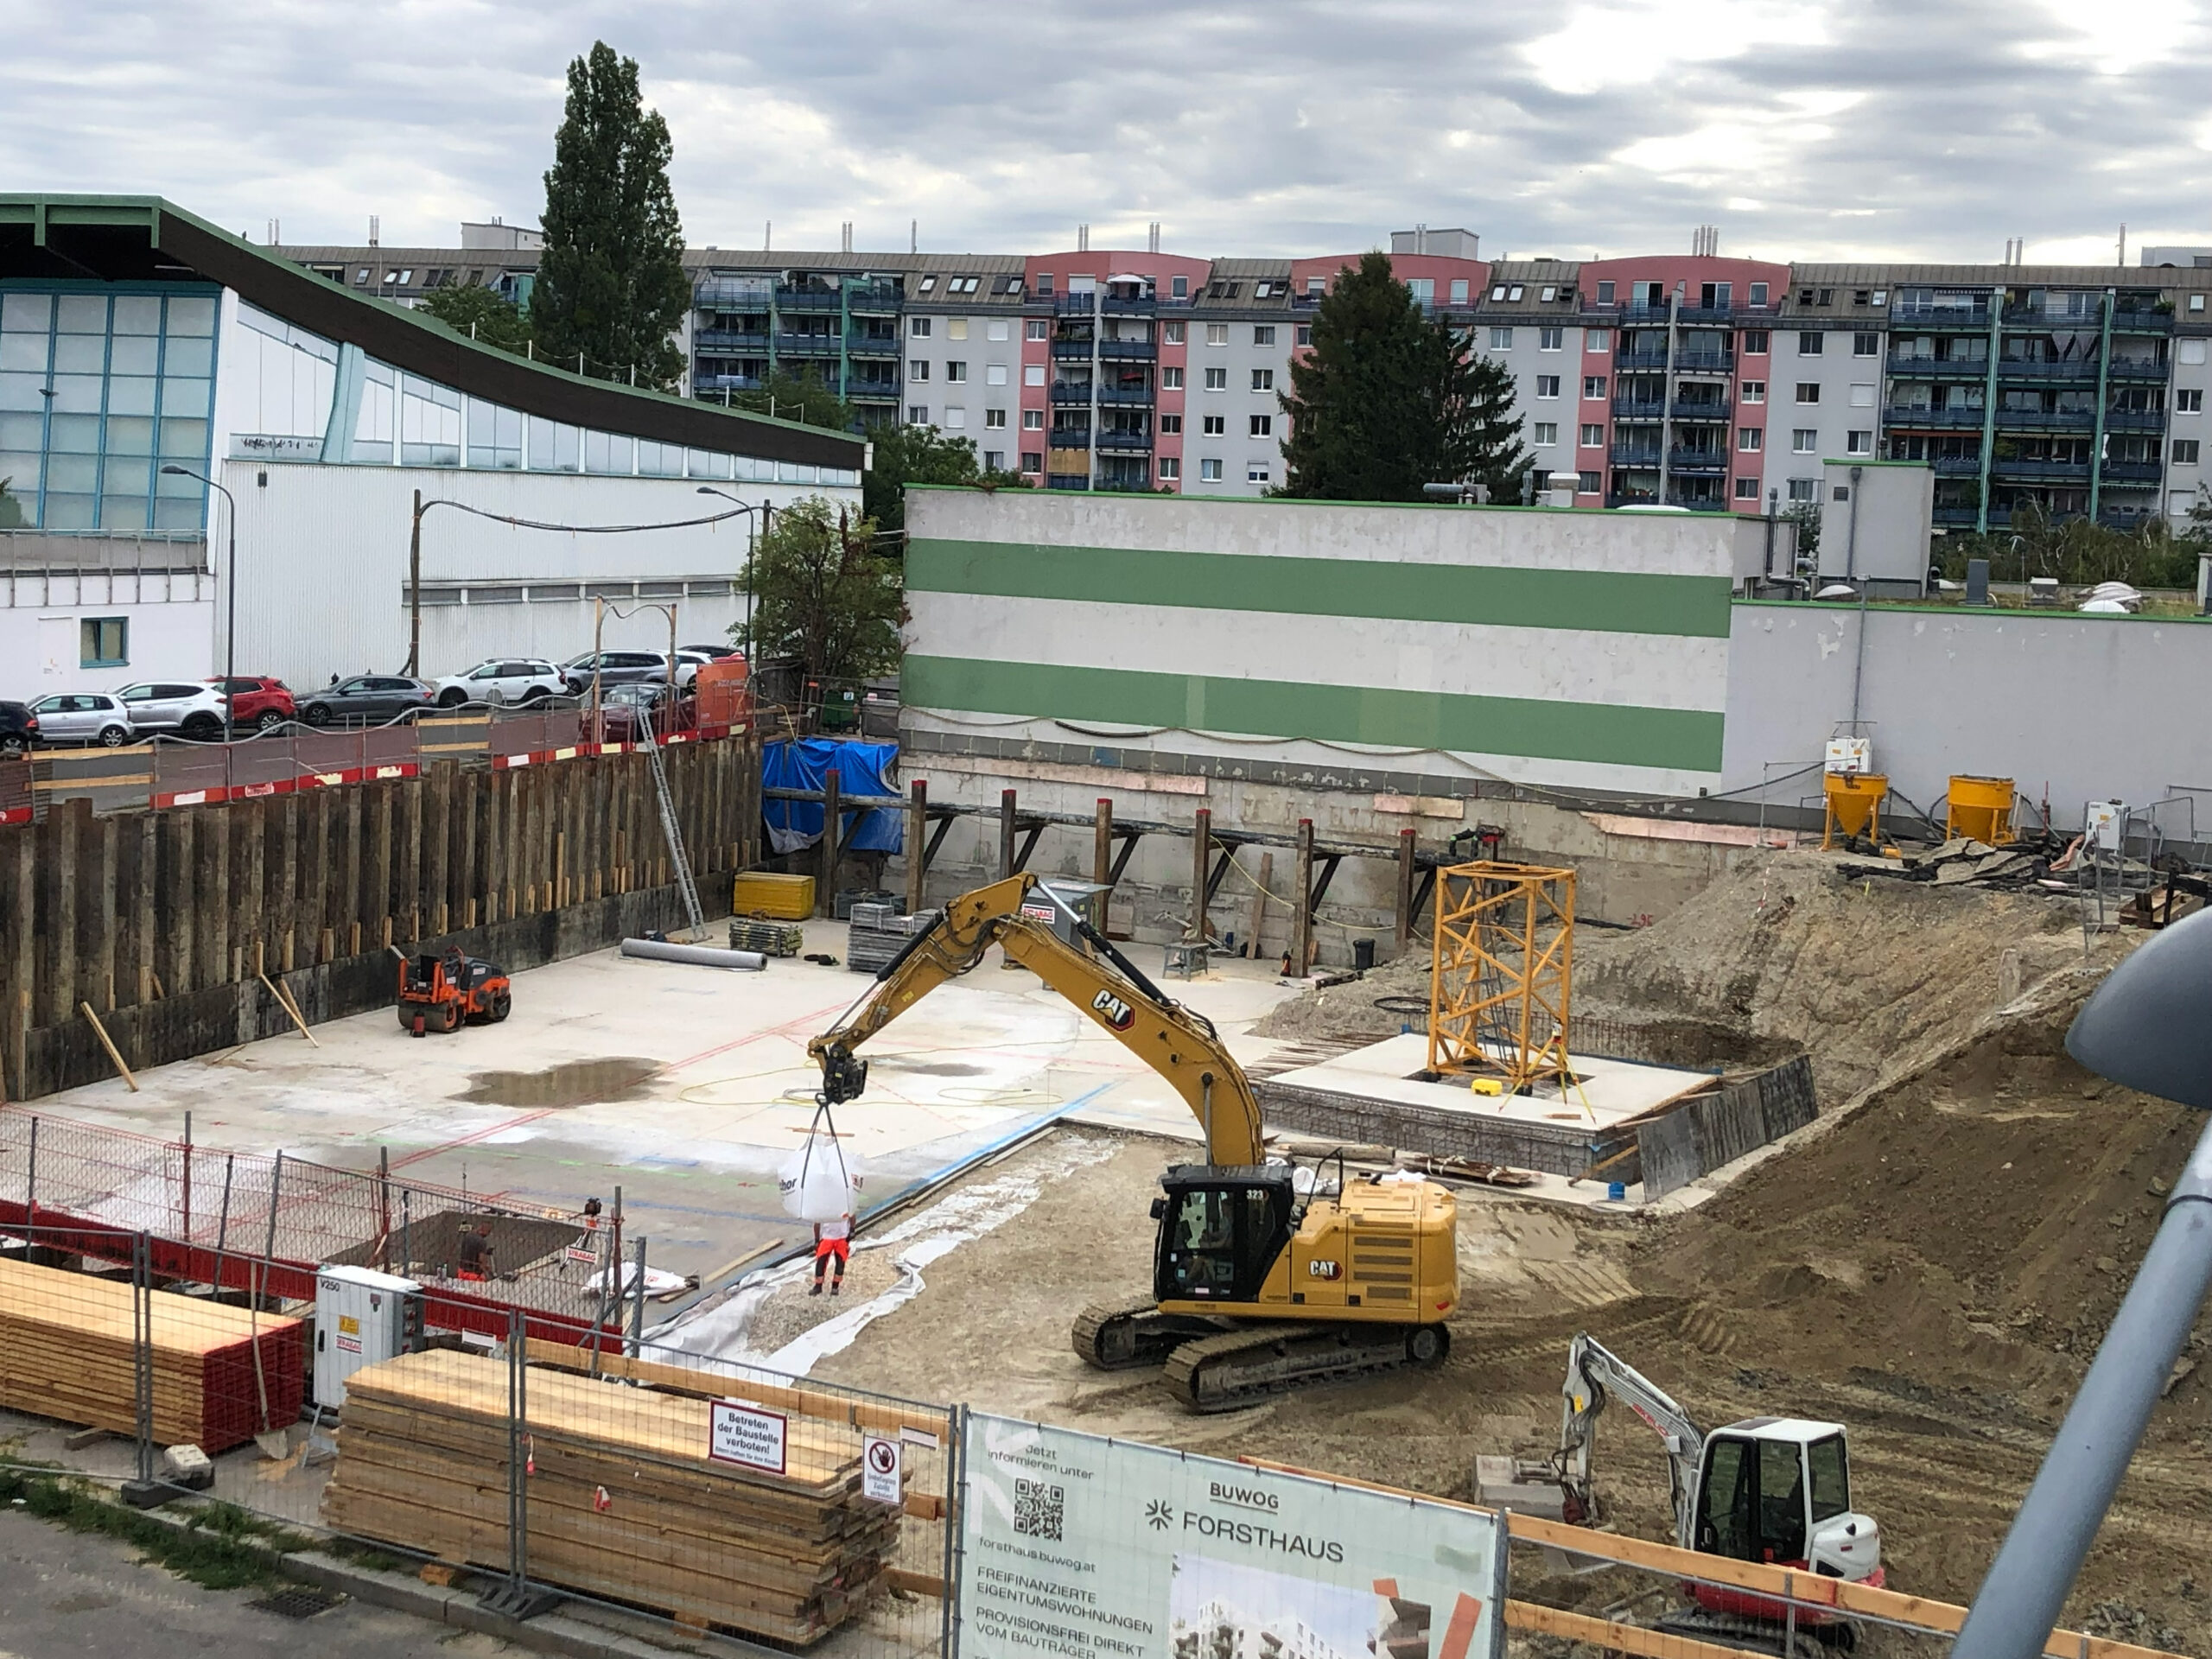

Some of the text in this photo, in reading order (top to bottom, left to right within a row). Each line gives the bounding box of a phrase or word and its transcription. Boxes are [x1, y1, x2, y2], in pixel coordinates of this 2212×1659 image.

[1093, 989, 1132, 1023] CAT
[1246, 1189, 1263, 1200] 323
[568, 1249, 596, 1262] STRABAG
[1310, 1260, 1336, 1276] CAT
[320, 1278, 340, 1292] V250
[728, 1412, 768, 1431] Betreten
[717, 1422, 779, 1445] der Baustelle
[726, 1437, 770, 1454] verboten!
[1026, 1444, 1057, 1459] Jetzt
[988, 1451, 1095, 1479] informieren unter
[1210, 1482, 1279, 1509] BUWOG
[1183, 1511, 1344, 1563] FORSTHAUS
[977, 1566, 1096, 1604] FREIFINANZIERTE
[976, 1582, 1154, 1635] EIGENTUMSWOHNUNGEN
[976, 1622, 1007, 1640] VOM
[976, 1606, 1145, 1657] PROVISIONSFREI DIREKT
